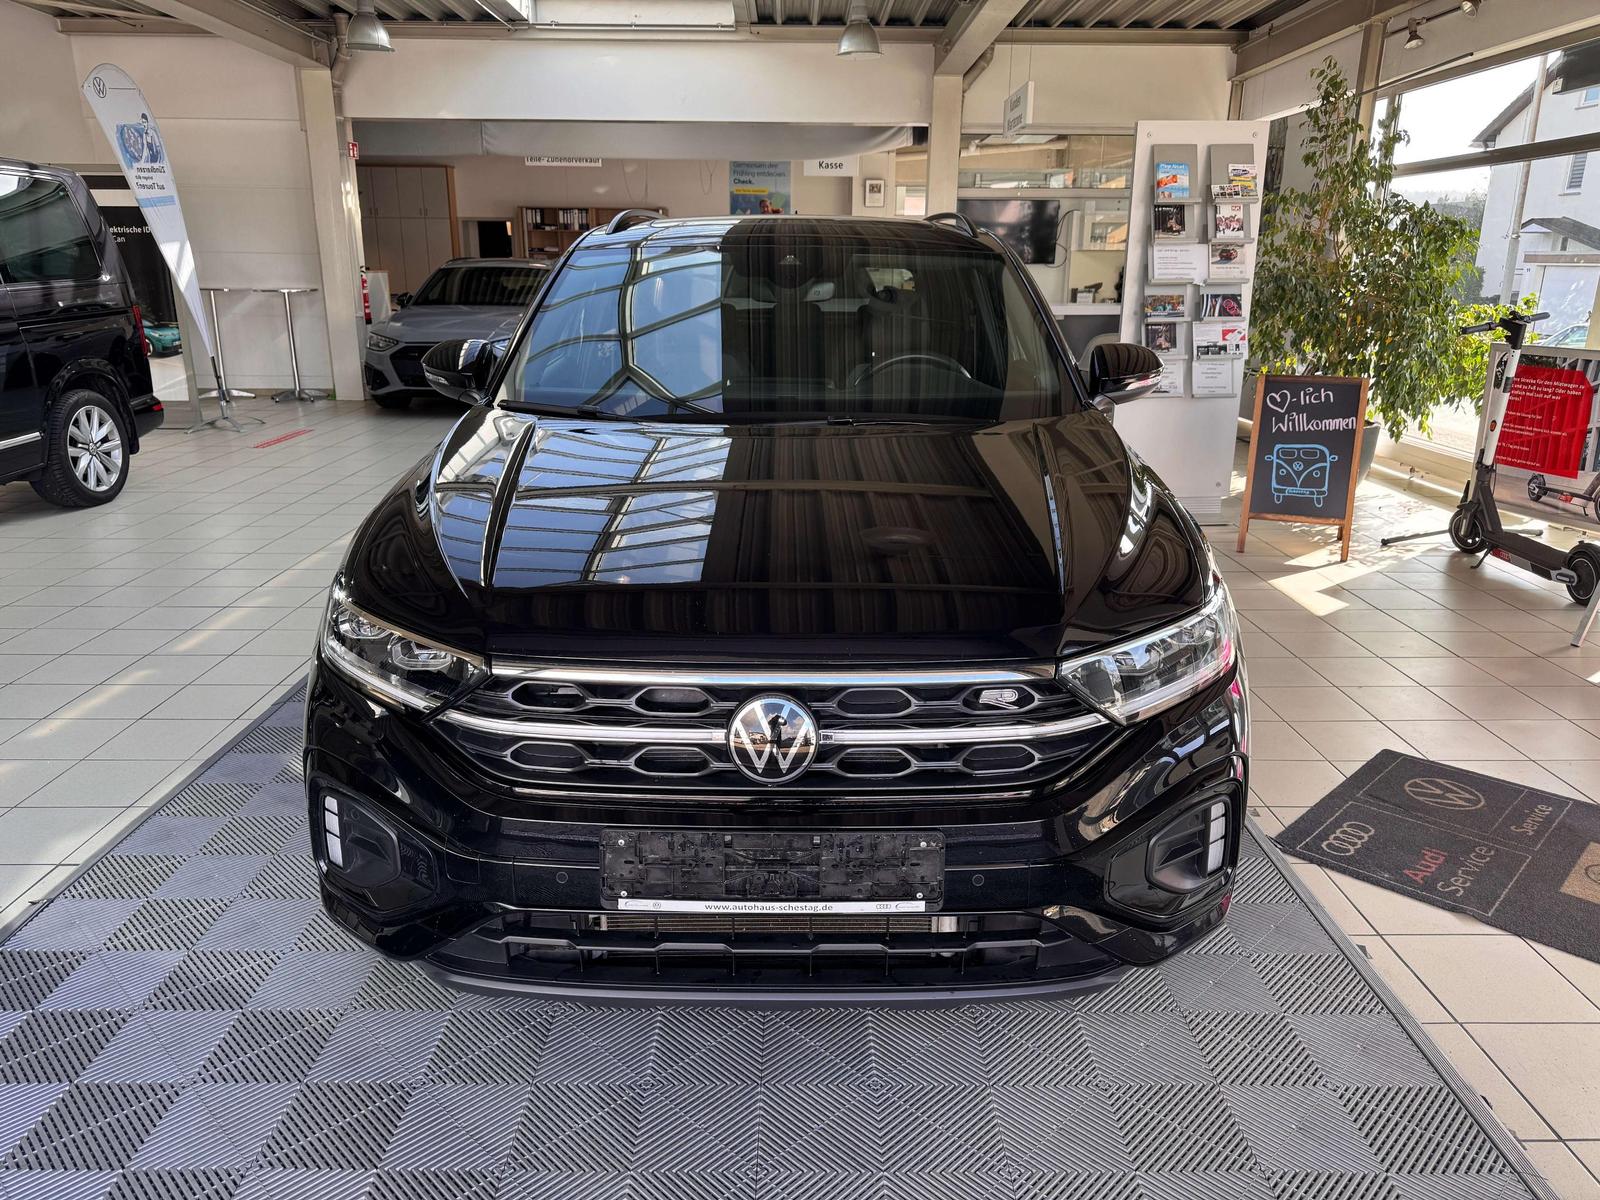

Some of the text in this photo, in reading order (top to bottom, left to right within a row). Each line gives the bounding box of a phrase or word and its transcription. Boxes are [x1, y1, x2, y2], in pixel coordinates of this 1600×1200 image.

[818, 160, 844, 170] Kasse
[1271, 412, 1357, 433] Willkommen
[1510, 804, 1553, 836] Service
[1403, 846, 1448, 885] Audi
[1436, 846, 1496, 897] Service
[704, 903, 834, 912] www.autohaus-schestag.de
